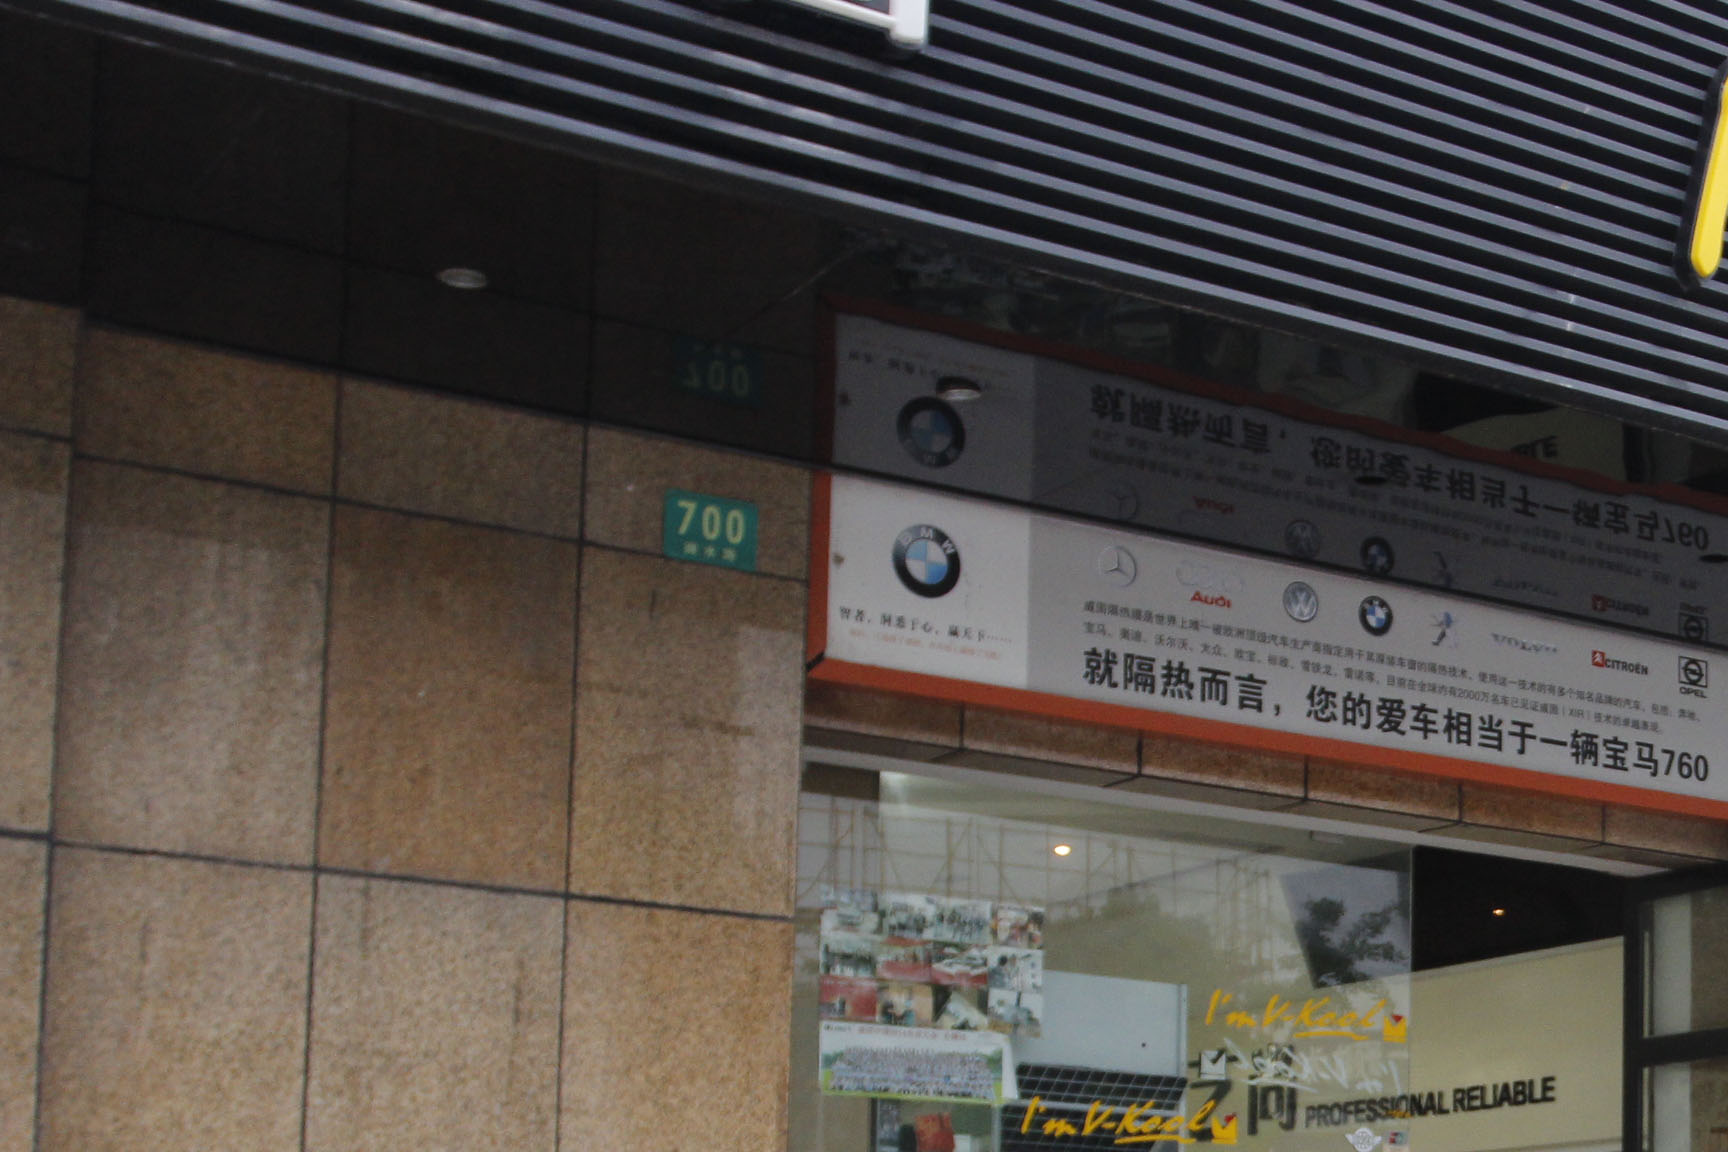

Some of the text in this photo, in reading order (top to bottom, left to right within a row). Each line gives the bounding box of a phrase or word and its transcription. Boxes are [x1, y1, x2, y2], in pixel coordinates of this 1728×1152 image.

[677, 499, 745, 545] 700
[1190, 590, 1233, 608] Audi
[1604, 657, 1649, 676] CITROËN
[1679, 686, 1708, 699] OPEL
[1205, 988, 1387, 1029] I'm V-Kool
[1021, 1095, 1215, 1137] I'm V-Kool
[1304, 1076, 1557, 1130] PROFESSIONAL RELIABLE
